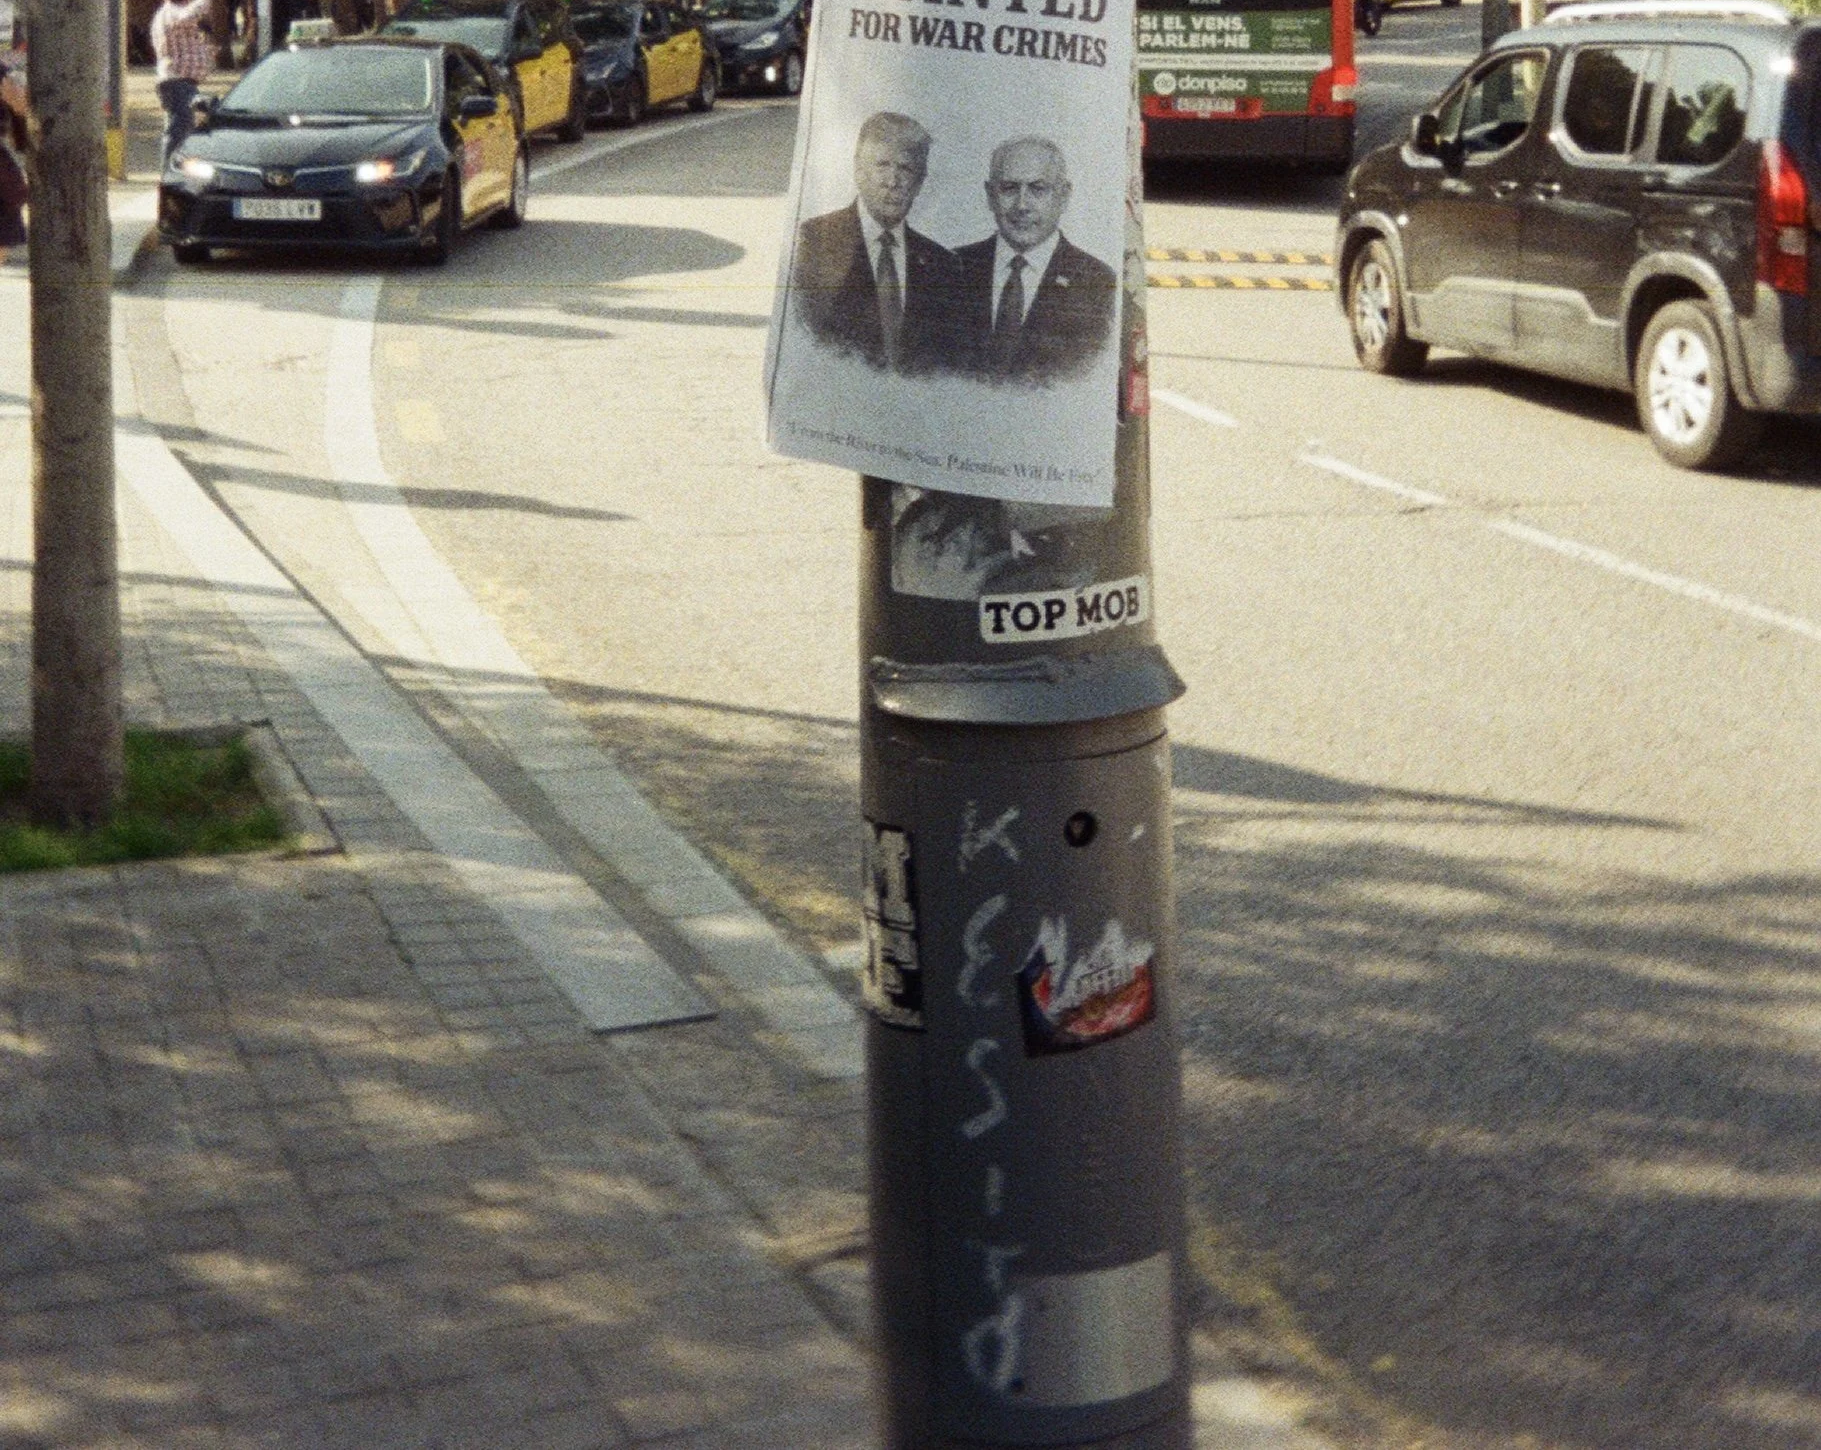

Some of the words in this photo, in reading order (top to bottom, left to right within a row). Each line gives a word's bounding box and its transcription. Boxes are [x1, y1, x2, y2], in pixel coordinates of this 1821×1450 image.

[850, 8, 901, 44] FOR
[908, 14, 985, 52] WAR
[993, 24, 1107, 68] CRIMES
[1163, 14, 1186, 31] EL
[1139, 33, 1250, 49] PARLEM-NE
[985, 599, 1066, 634] TOP
[1076, 586, 1141, 628] MOB
